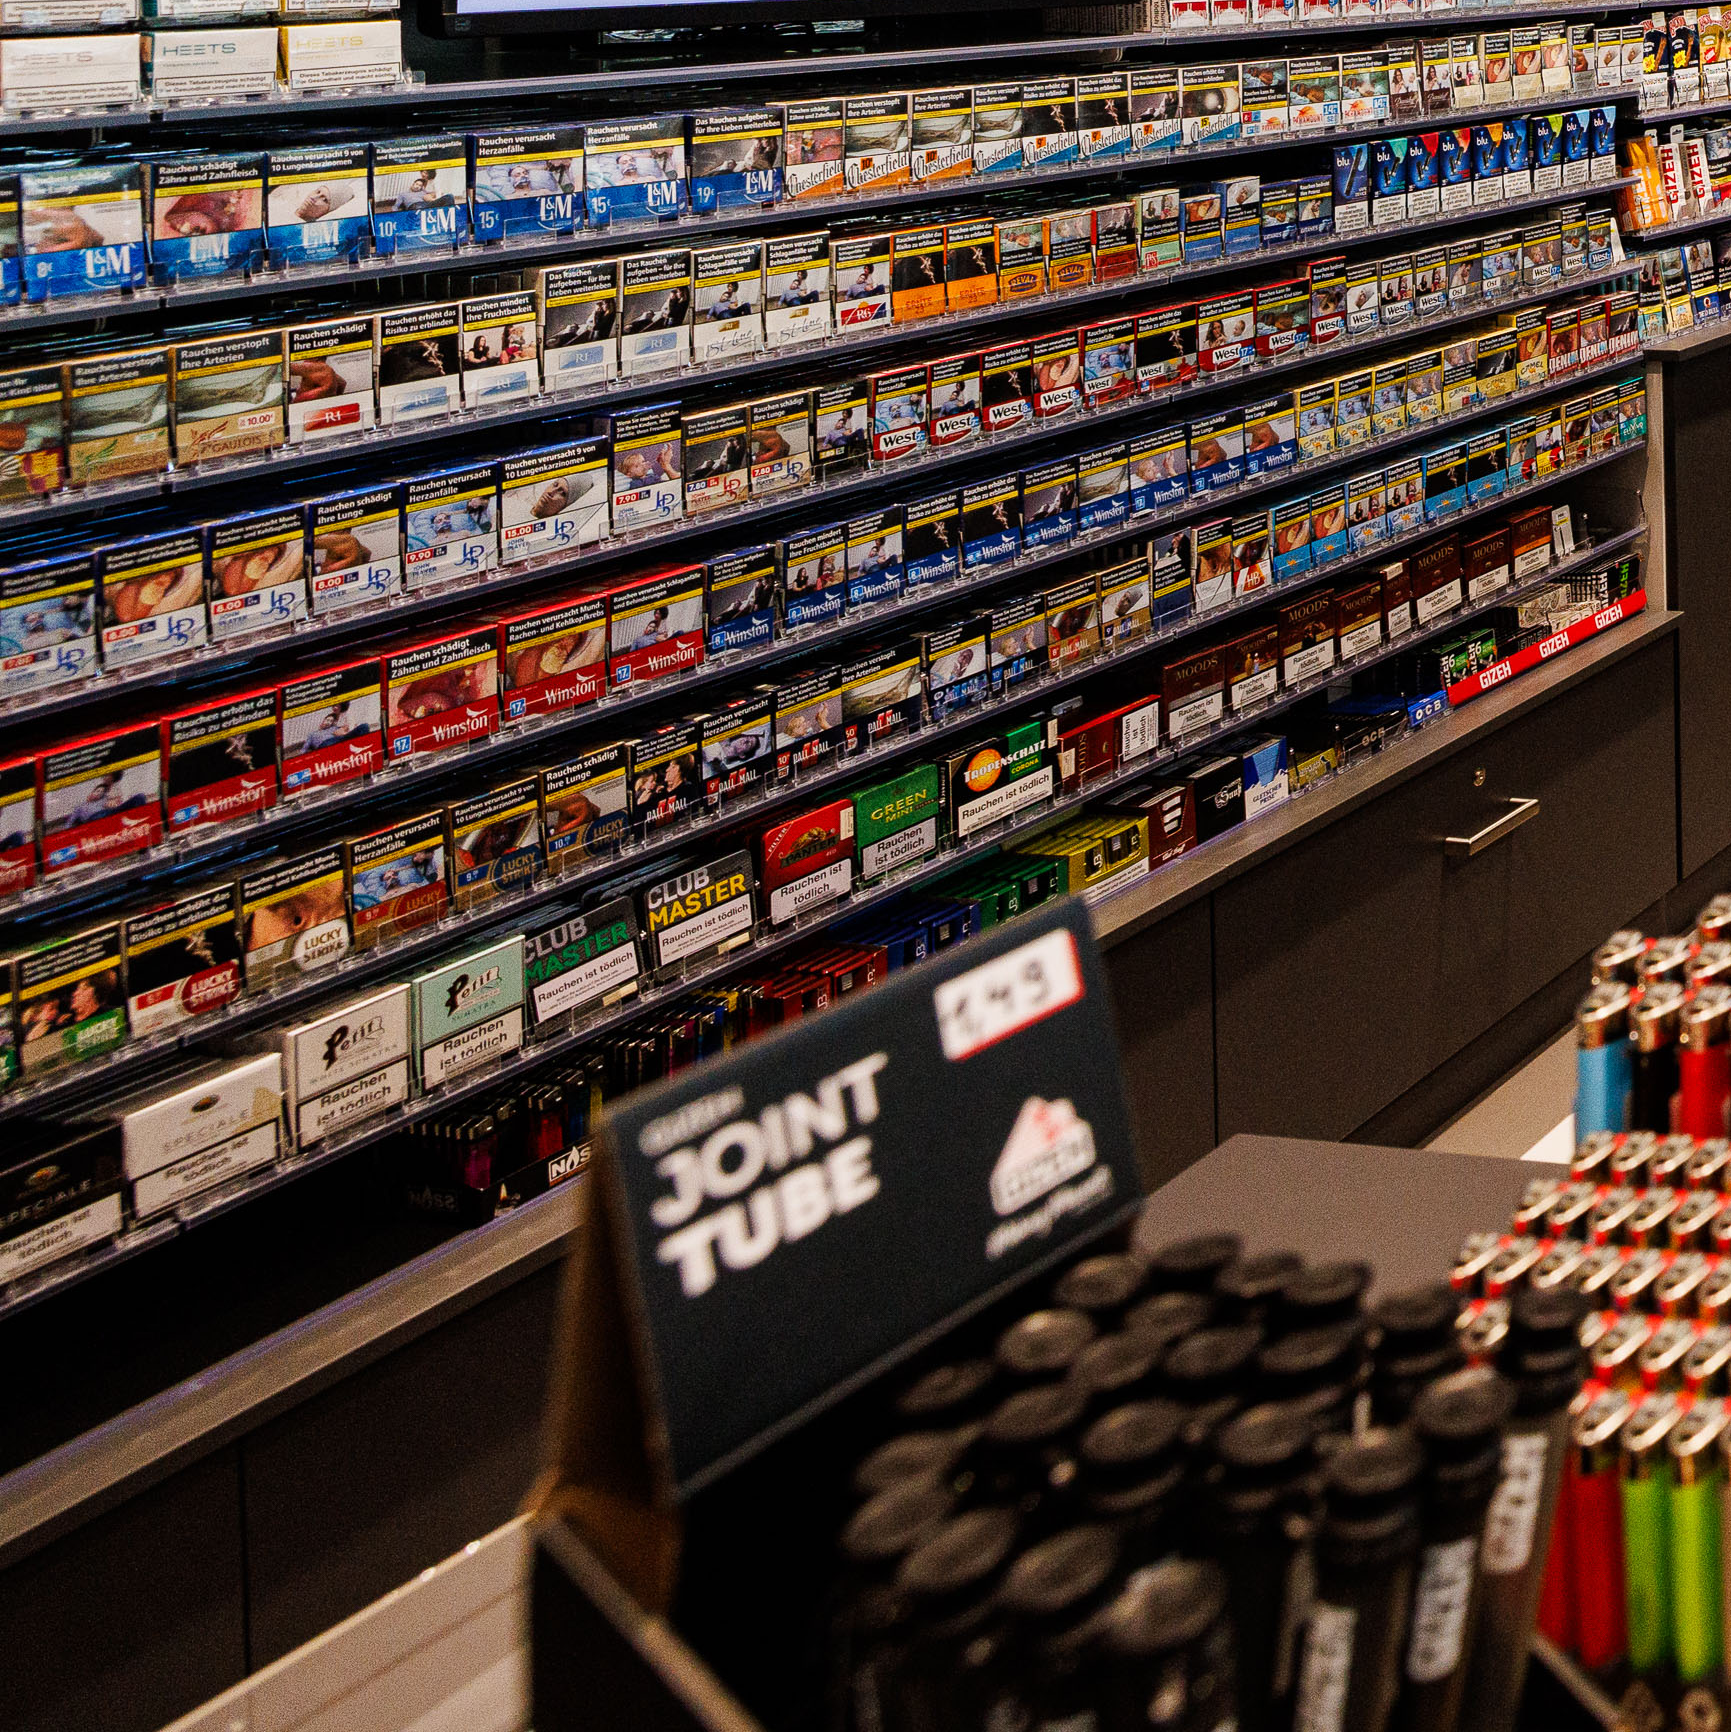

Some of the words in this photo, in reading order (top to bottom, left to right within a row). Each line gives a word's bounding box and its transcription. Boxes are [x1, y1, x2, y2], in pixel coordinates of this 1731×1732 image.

[162, 41, 237, 56] HEETS
[479, 144, 525, 155] Herzanfälle
[514, 132, 556, 143] verursacht
[484, 305, 532, 319] Fruchtbarkeit
[499, 296, 529, 307] mindert
[225, 338, 270, 353] verstopft
[293, 340, 310, 350] Ihre
[312, 337, 339, 349] Lunge
[1213, 346, 1240, 365] West
[1042, 389, 1073, 408] West
[990, 402, 1023, 422] West
[1417, 542, 1456, 570] MOODS
[1595, 604, 1623, 630] GIZEH
[432, 639, 470, 657] schädigt
[1539, 631, 1570, 659] GIZEH
[391, 664, 420, 680] Zähne
[442, 644, 491, 665] Zahnfleisch
[649, 648, 695, 672] Winston
[1479, 661, 1512, 690] GIZEH
[433, 715, 488, 743] Winston
[963, 739, 1046, 784] TROPENSCHATZ
[1011, 757, 1039, 774] CORONA
[871, 788, 928, 821] GREEN
[961, 793, 1003, 820] Rauchen
[1005, 788, 1017, 801] ist
[1018, 772, 1050, 793] tödlich
[885, 806, 913, 824] MINI
[767, 827, 788, 854] FILTER
[877, 826, 923, 853] Rauchen
[890, 836, 925, 862] tödlich
[649, 867, 710, 909] CLUB
[650, 873, 746, 932] MASTER
[304, 929, 343, 948] LUCKY
[524, 920, 629, 983] MASTER
[600, 949, 633, 974] tödlich
[650, 1050, 890, 1231] JOINT
[655, 1137, 881, 1299] TUBE
